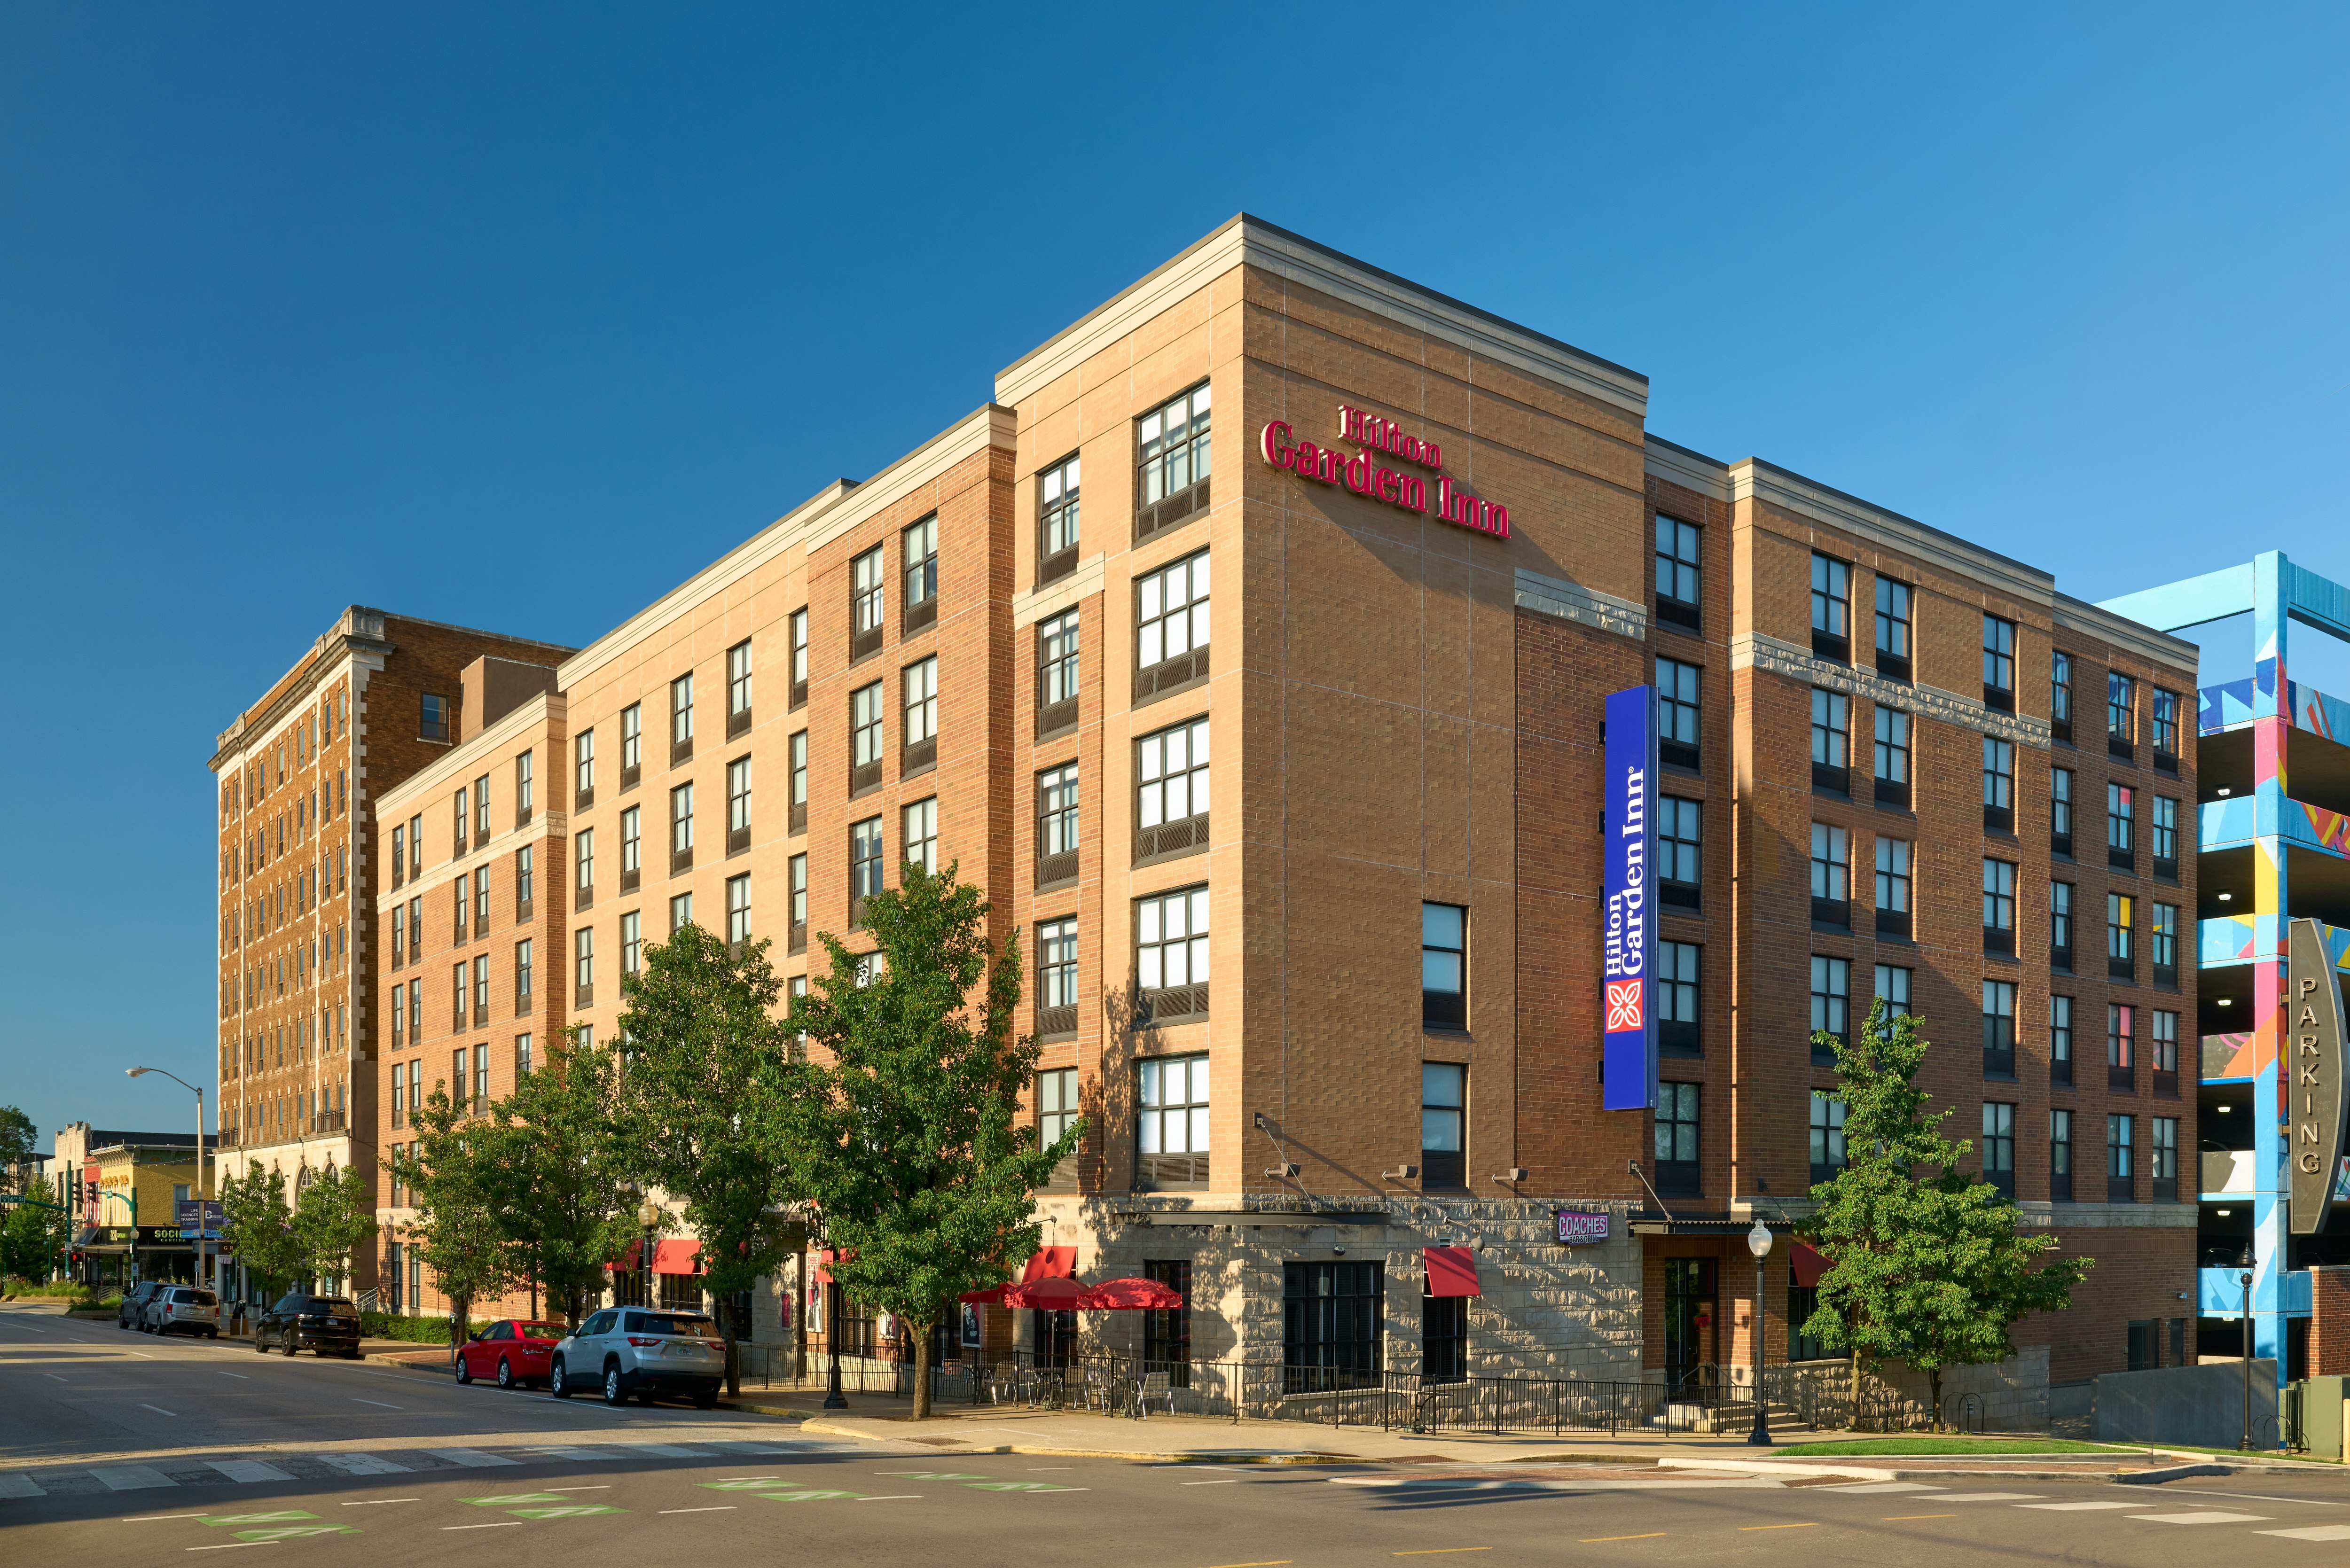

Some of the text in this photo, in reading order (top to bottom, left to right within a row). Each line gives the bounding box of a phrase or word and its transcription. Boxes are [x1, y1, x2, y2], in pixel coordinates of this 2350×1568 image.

[1261, 420, 1512, 539] Garden Inn
[1338, 405, 1443, 469] Hilton
[1606, 892, 1621, 977] Hilton
[1622, 839, 1643, 975] Garden
[2298, 978, 2321, 1174] PARKING
[155, 1230, 181, 1238] SOCI
[1559, 1216, 1606, 1236] COACHES
